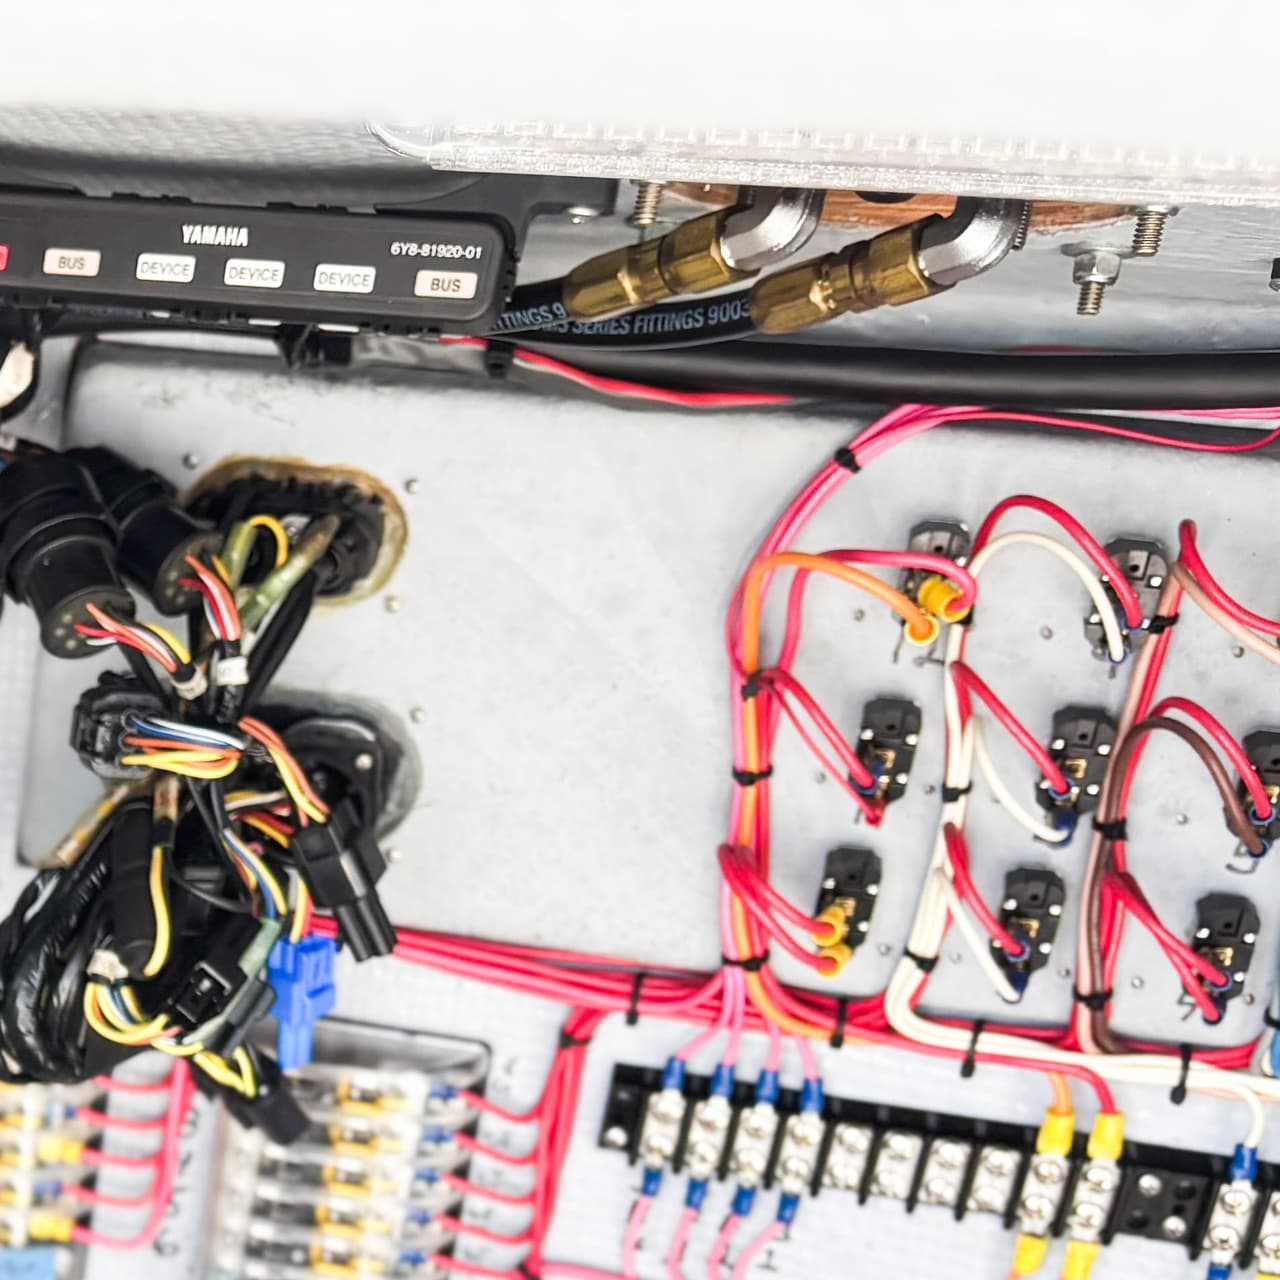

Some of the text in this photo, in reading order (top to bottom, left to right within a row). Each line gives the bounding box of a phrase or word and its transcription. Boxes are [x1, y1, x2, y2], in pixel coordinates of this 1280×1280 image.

[182, 225, 248, 246] YAMAHA
[390, 241, 482, 260] 6Y8-81920-01
[57, 256, 86, 270] BUS
[141, 261, 191, 277] DEVICE
[228, 266, 279, 283] DEVICE
[318, 271, 371, 288] DEVICE
[430, 277, 462, 293] BUS
[633, 310, 704, 335] FITTINGS
